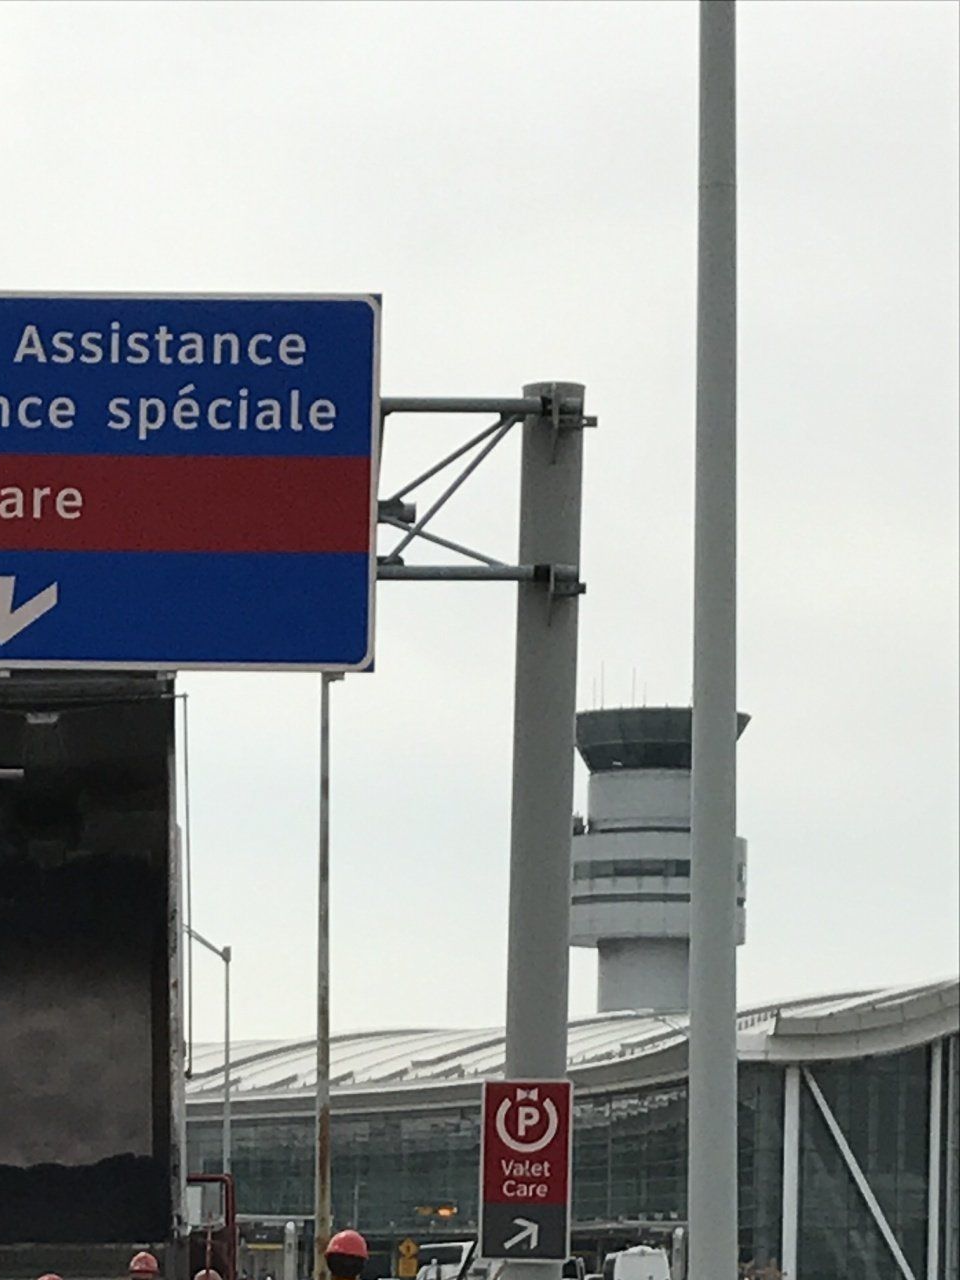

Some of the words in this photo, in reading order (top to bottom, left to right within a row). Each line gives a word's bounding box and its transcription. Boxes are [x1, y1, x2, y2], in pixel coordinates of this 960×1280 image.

[13, 321, 307, 367] Assistance
[107, 383, 337, 441] spéciale
[501, 1159, 551, 1177] Valet
[502, 1180, 548, 1198] Care
